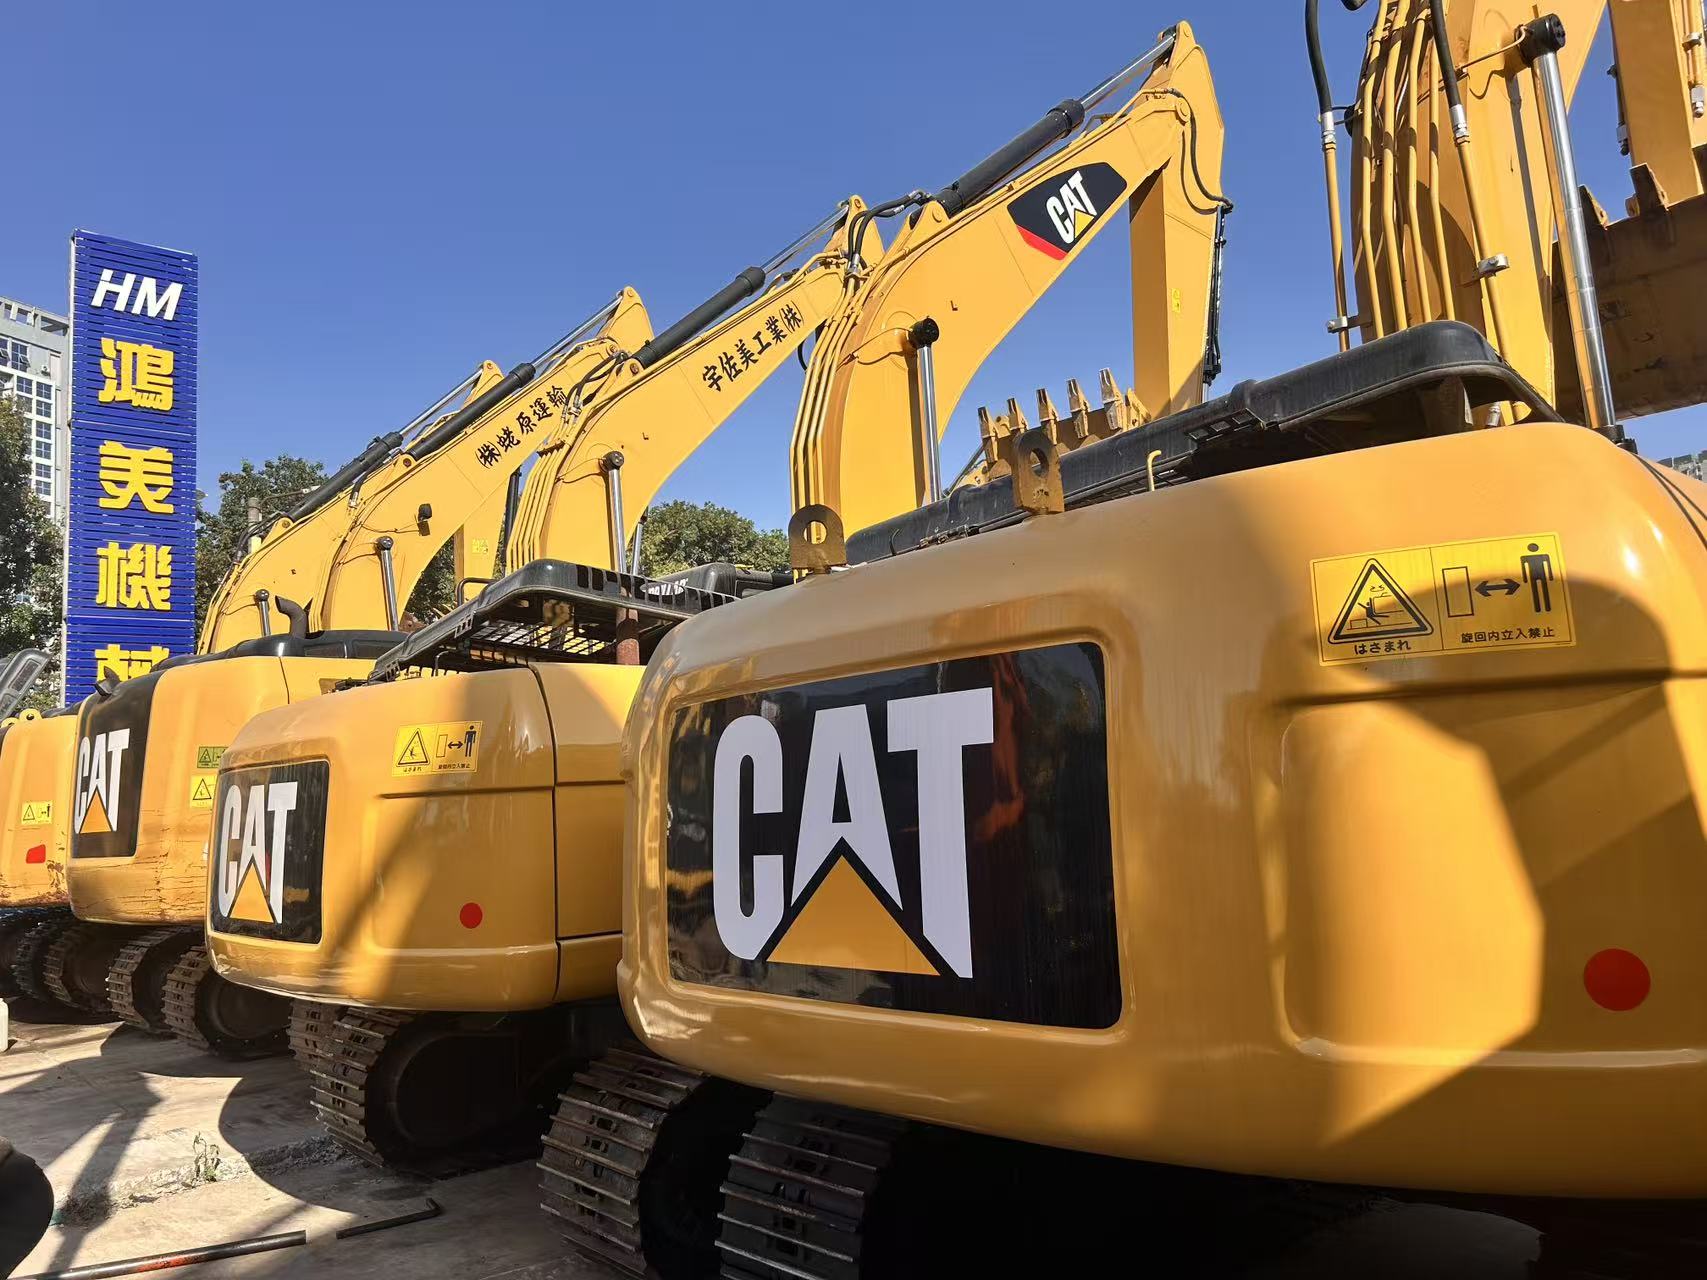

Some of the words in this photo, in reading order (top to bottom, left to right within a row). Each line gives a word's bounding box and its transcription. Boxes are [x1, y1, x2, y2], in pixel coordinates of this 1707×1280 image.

[1046, 171, 1097, 243] CAT
[91, 268, 182, 320] HM
[702, 300, 804, 392] 宇佐美工業(株)
[1354, 639, 1411, 655] はさまれ
[1461, 628, 1555, 643] 旋回内立入禁止
[73, 728, 131, 834] CAT
[218, 782, 298, 924] CAT
[713, 687, 994, 978] CAT
